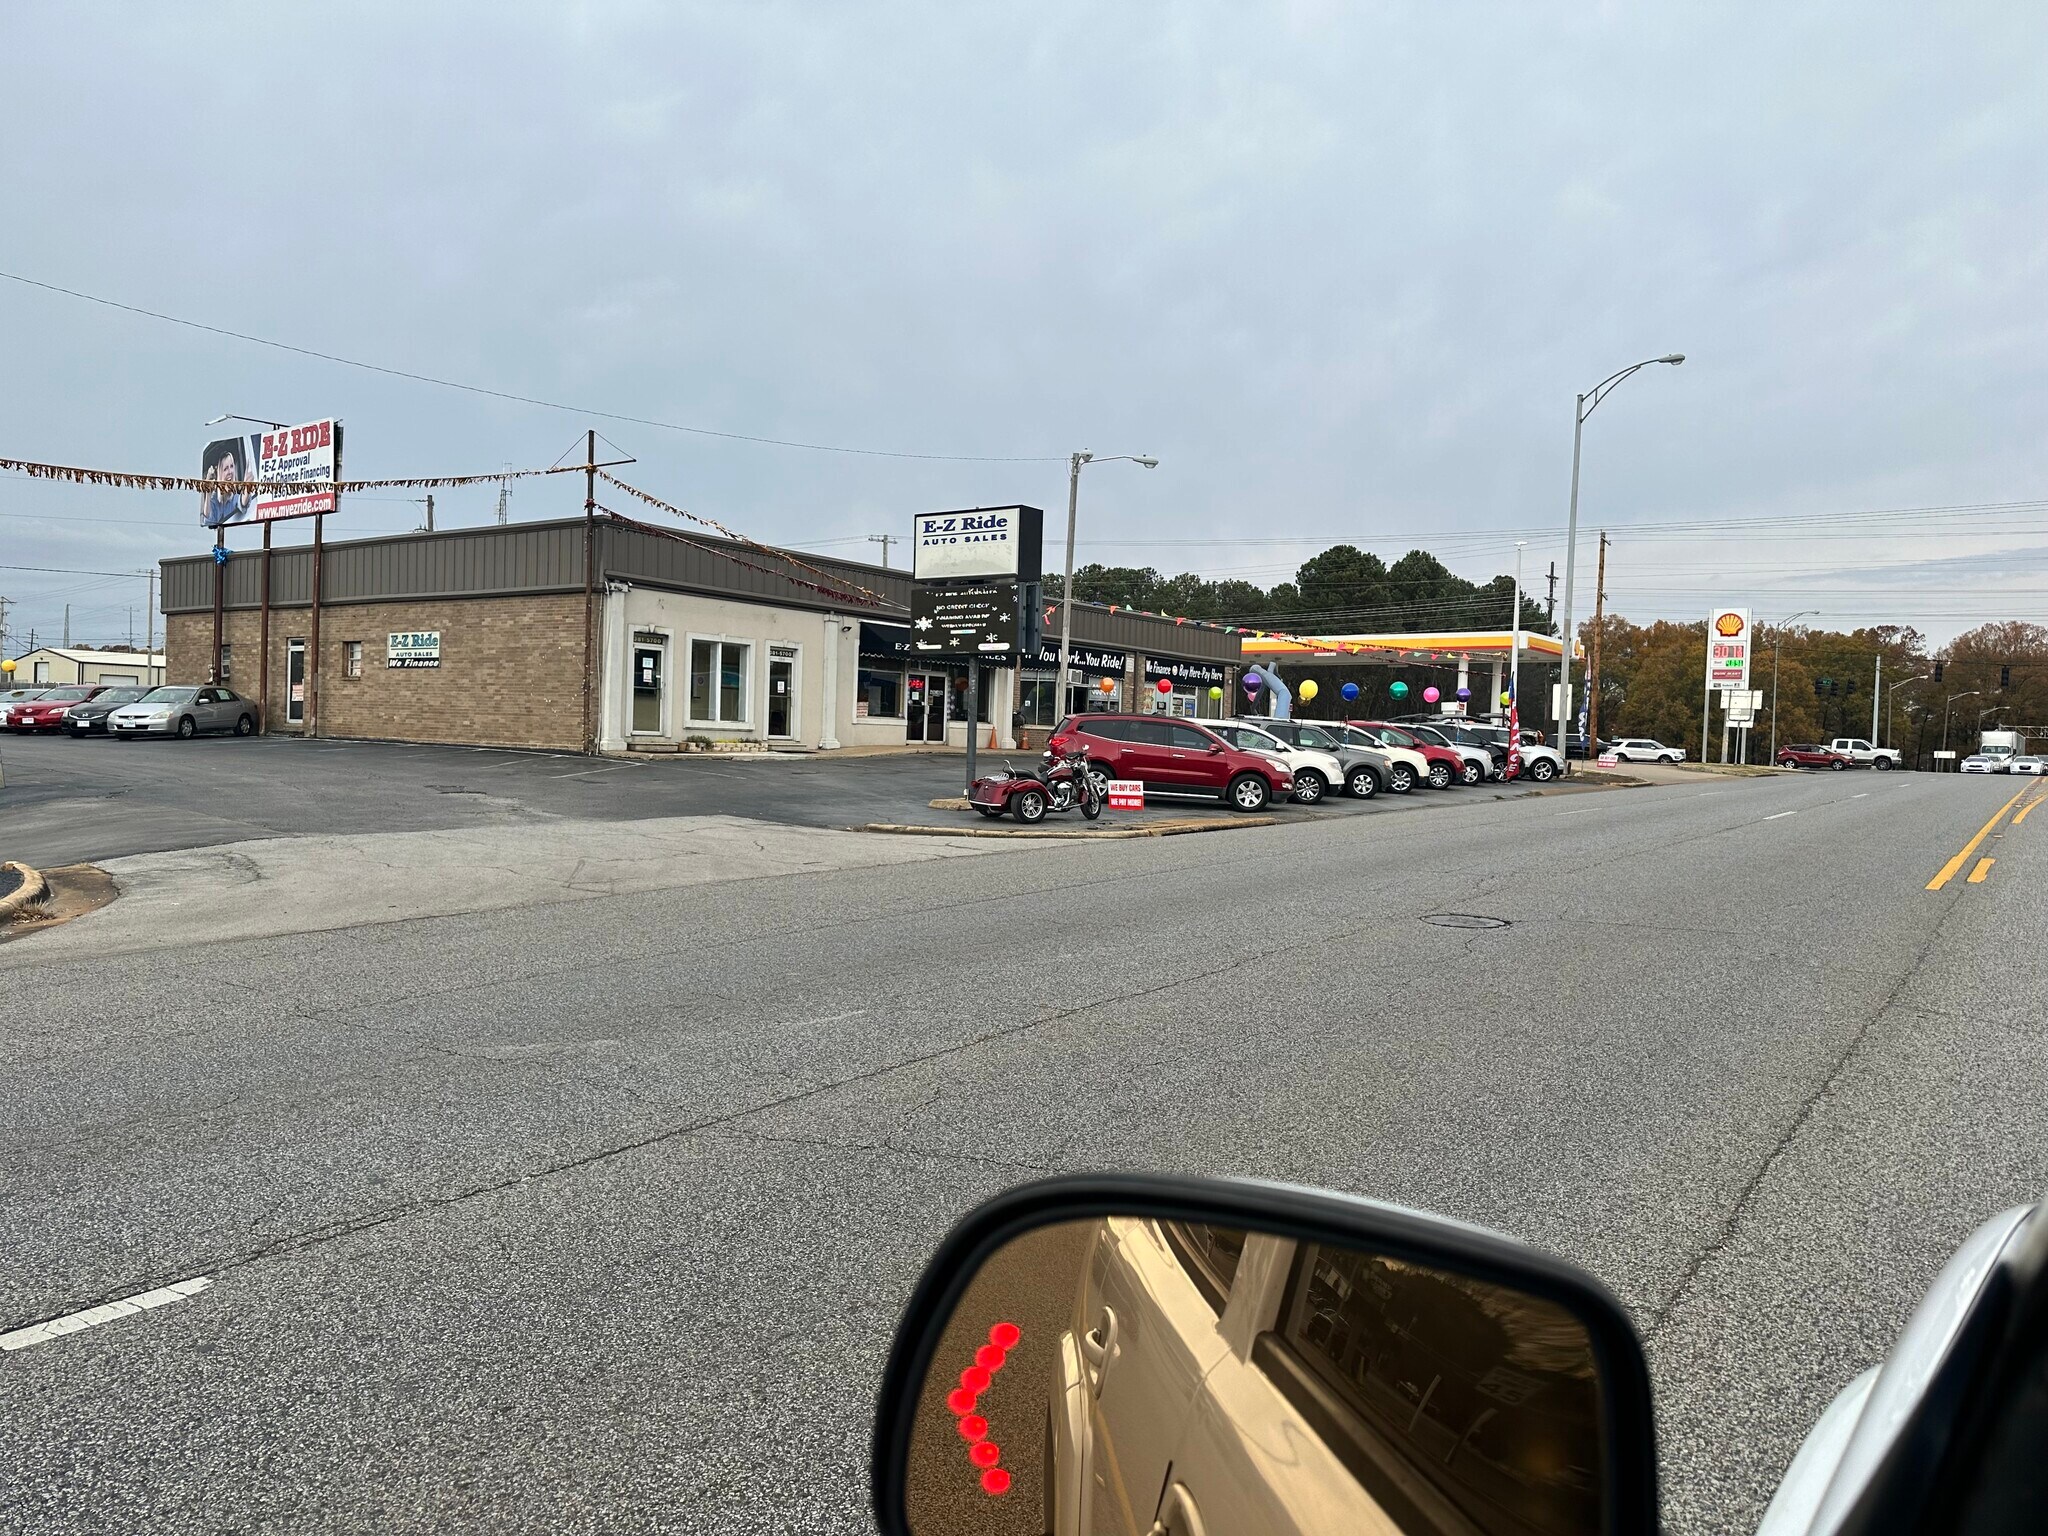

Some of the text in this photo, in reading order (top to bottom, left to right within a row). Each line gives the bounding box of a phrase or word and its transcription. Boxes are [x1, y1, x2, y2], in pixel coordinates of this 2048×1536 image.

[262, 421, 331, 460] E-Z RIDE
[278, 452, 310, 471] Approval
[276, 471, 299, 484] Chance
[300, 464, 330, 480] Financing
[258, 497, 331, 519] www.myezride.com
[923, 515, 1008, 534] E-Z Ride
[923, 533, 1007, 546] AUTO SALES
[390, 633, 438, 648] E-Z Ride
[404, 659, 439, 667] Finance
[1101, 654, 1124, 670] Ride!
[1146, 660, 1153, 672] We
[1153, 661, 1171, 675] Finance
[1179, 664, 1189, 680] Buy
[1211, 668, 1223, 681] Here
[908, 680, 924, 689] OPEN
[1111, 798, 1119, 806] WE
